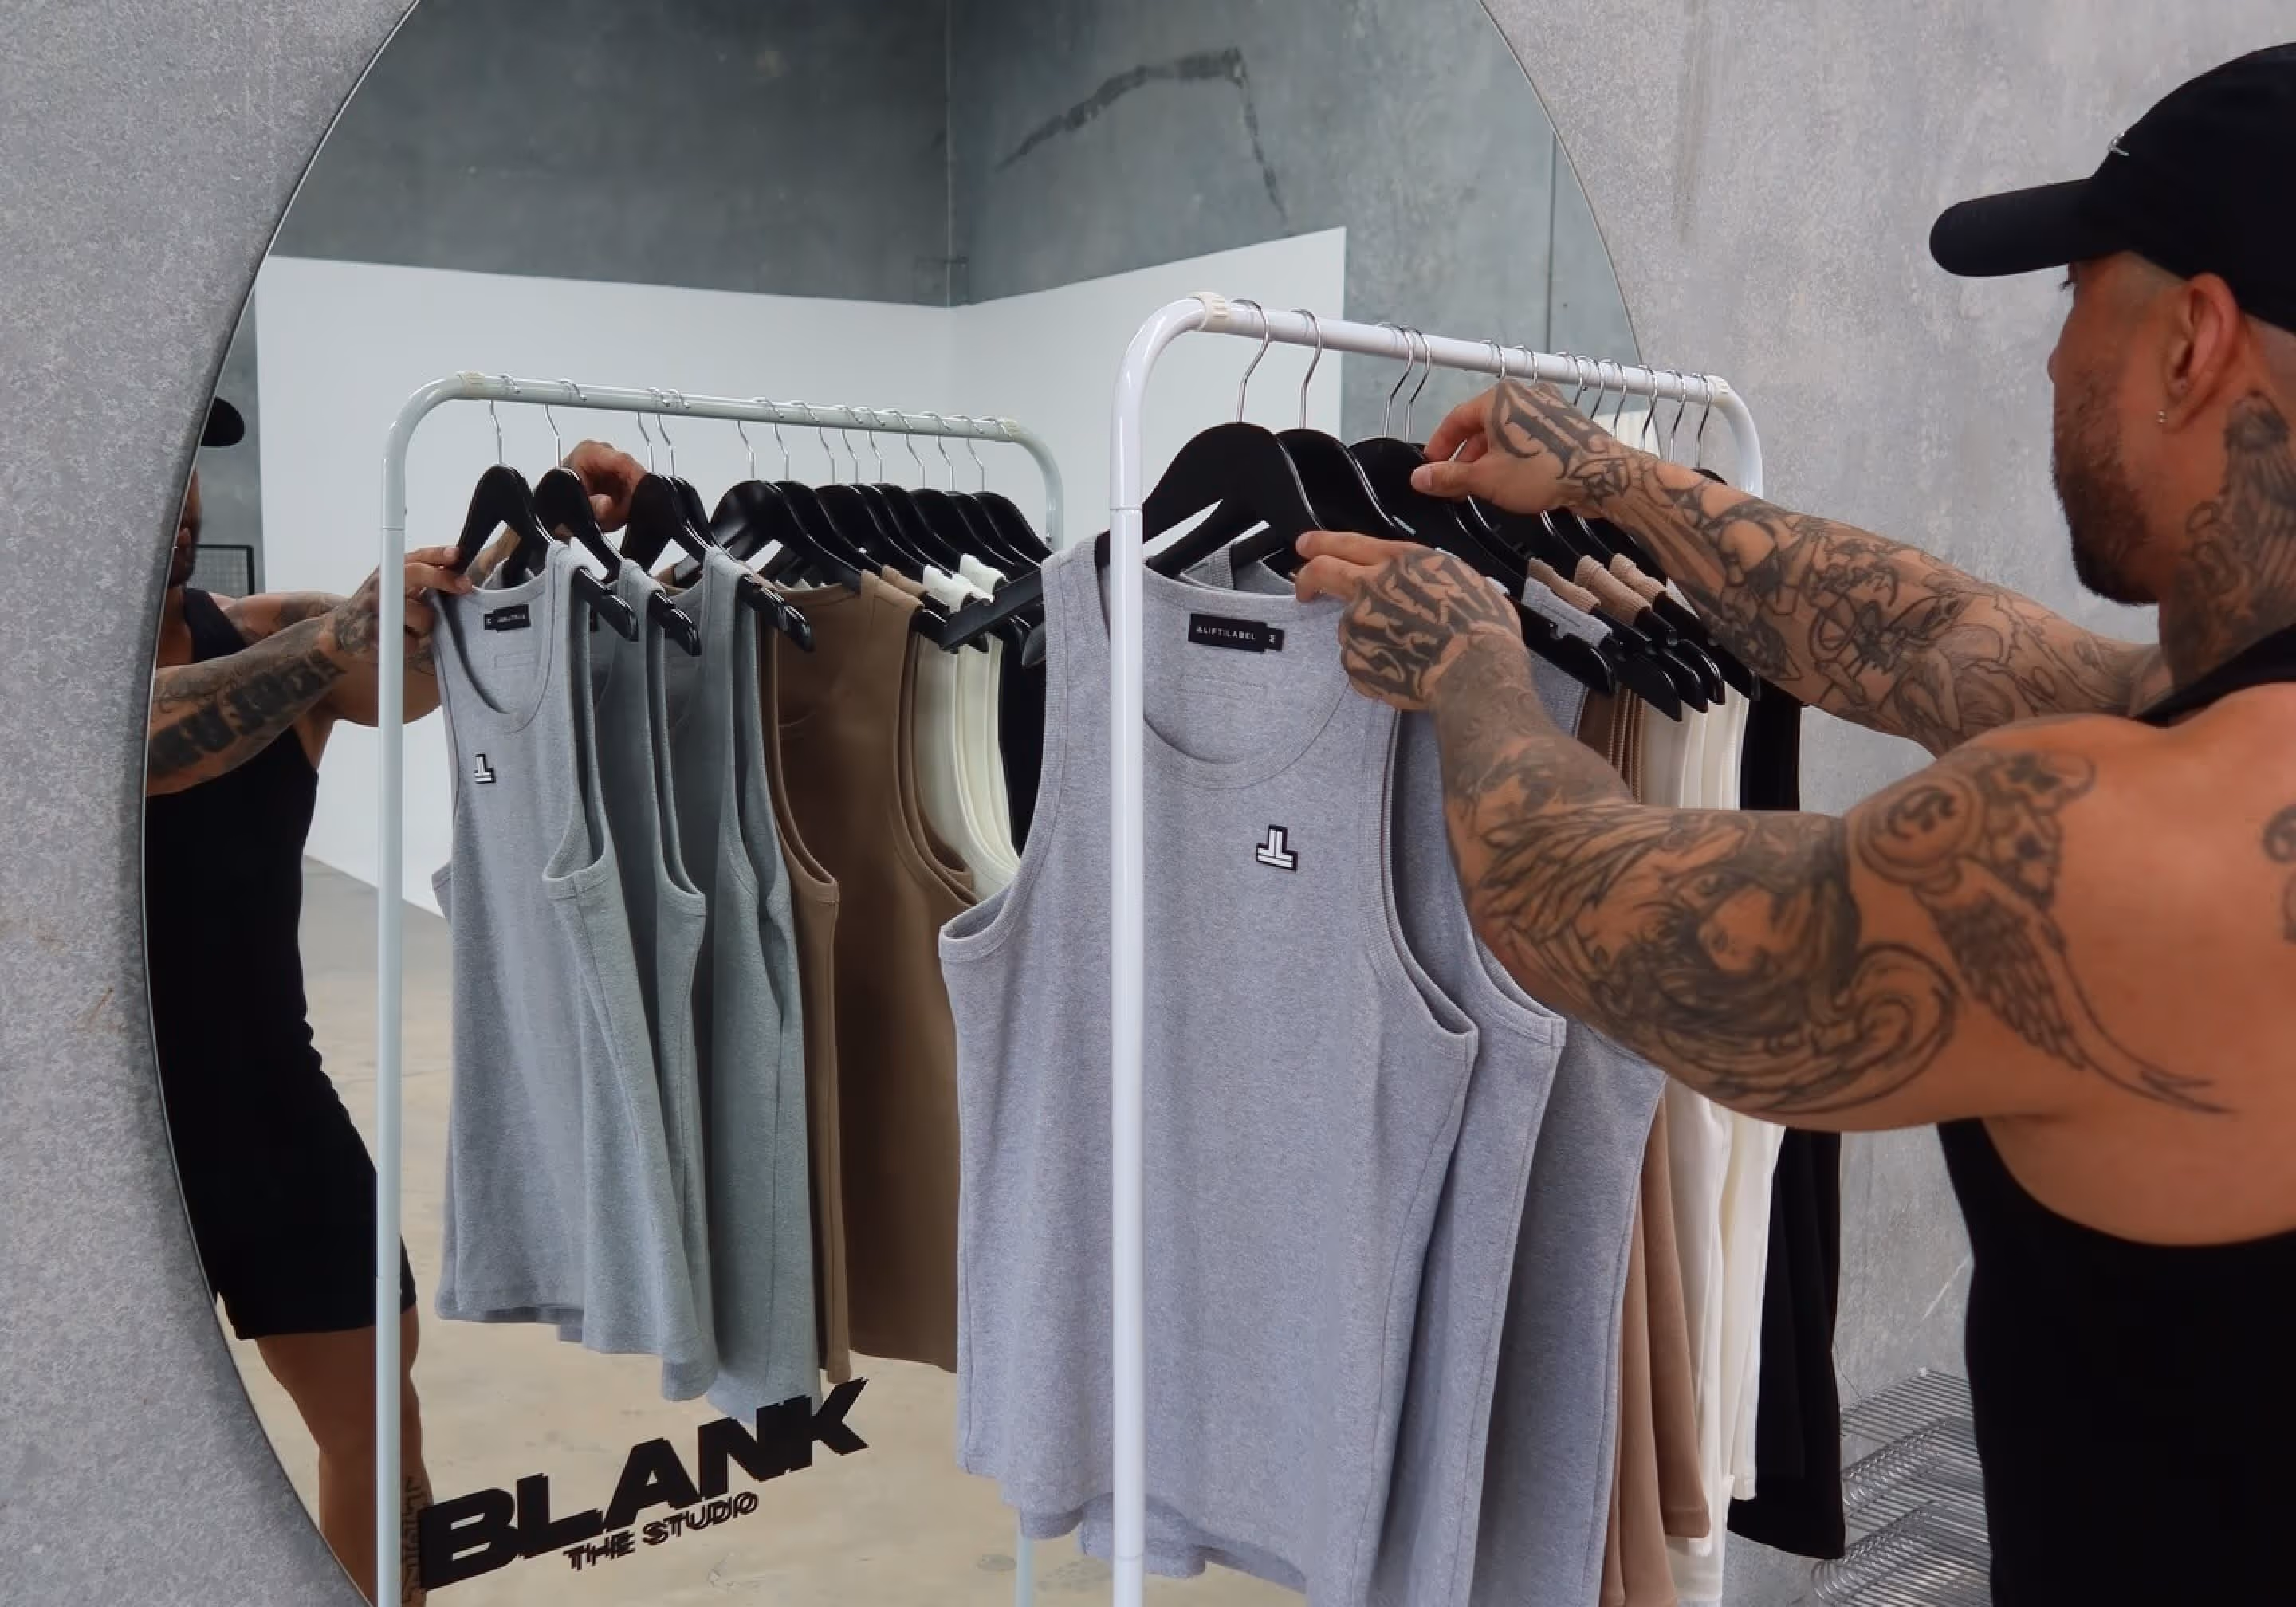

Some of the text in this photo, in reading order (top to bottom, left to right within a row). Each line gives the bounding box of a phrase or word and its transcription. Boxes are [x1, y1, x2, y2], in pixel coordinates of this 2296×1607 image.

[419, 1377, 869, 1591] BLANK
[563, 1491, 759, 1571] THE STUDIO
